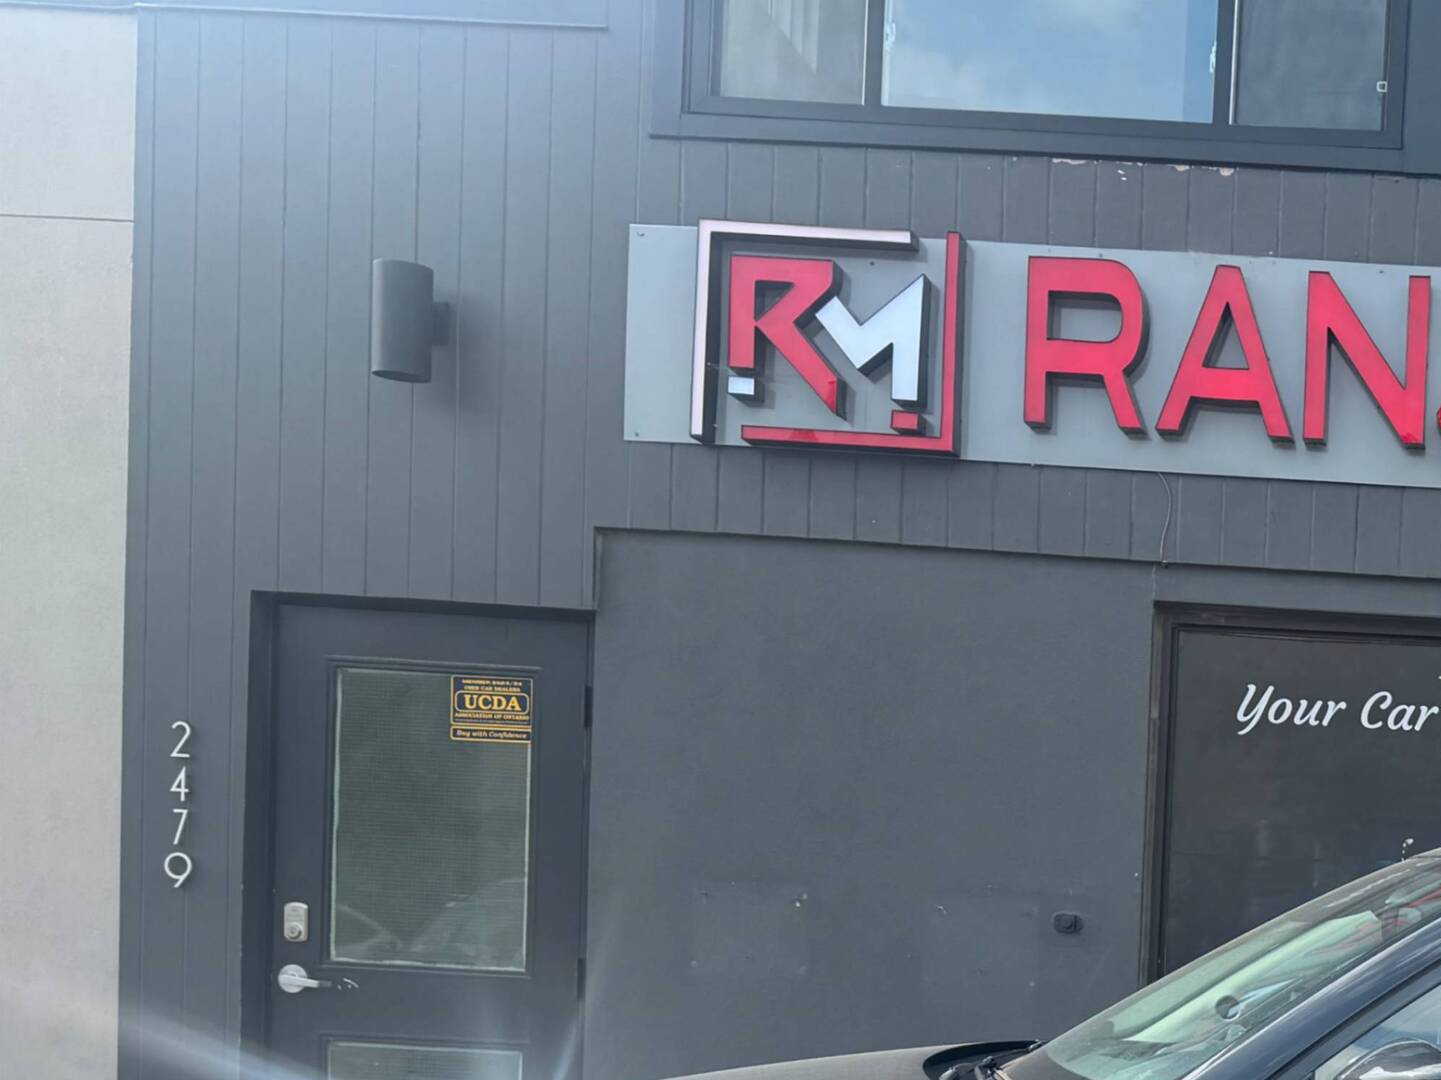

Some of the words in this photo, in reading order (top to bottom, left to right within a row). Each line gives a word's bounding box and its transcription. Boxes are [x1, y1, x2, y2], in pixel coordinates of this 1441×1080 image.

[727, 254, 931, 420] RM
[463, 694, 522, 711] UCDA
[1236, 683, 1347, 735] Your
[1360, 690, 1439, 732] Car
[164, 721, 193, 888] 2479
